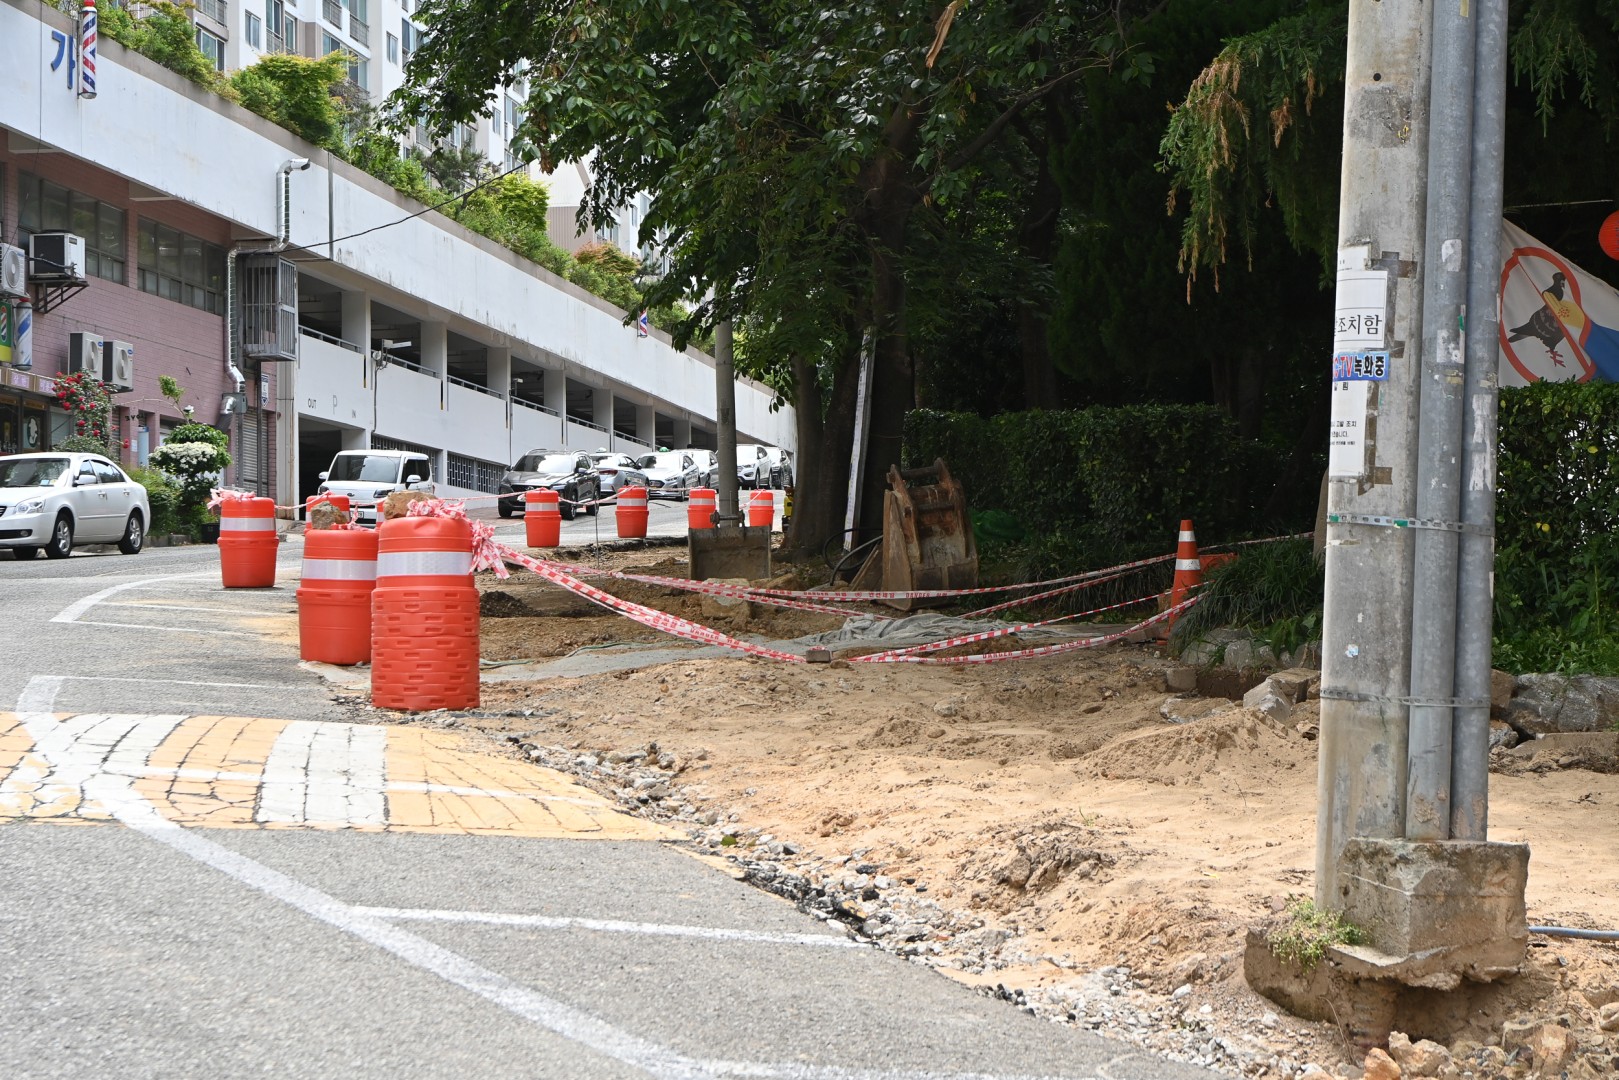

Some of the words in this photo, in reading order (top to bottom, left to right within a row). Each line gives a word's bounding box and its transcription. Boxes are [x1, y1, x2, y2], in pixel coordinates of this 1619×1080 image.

[51, 30, 76, 90] 가
[1334, 314, 1383, 337] 조치함
[1354, 355, 1385, 377] 녹화중
[307, 397, 317, 409] OUT
